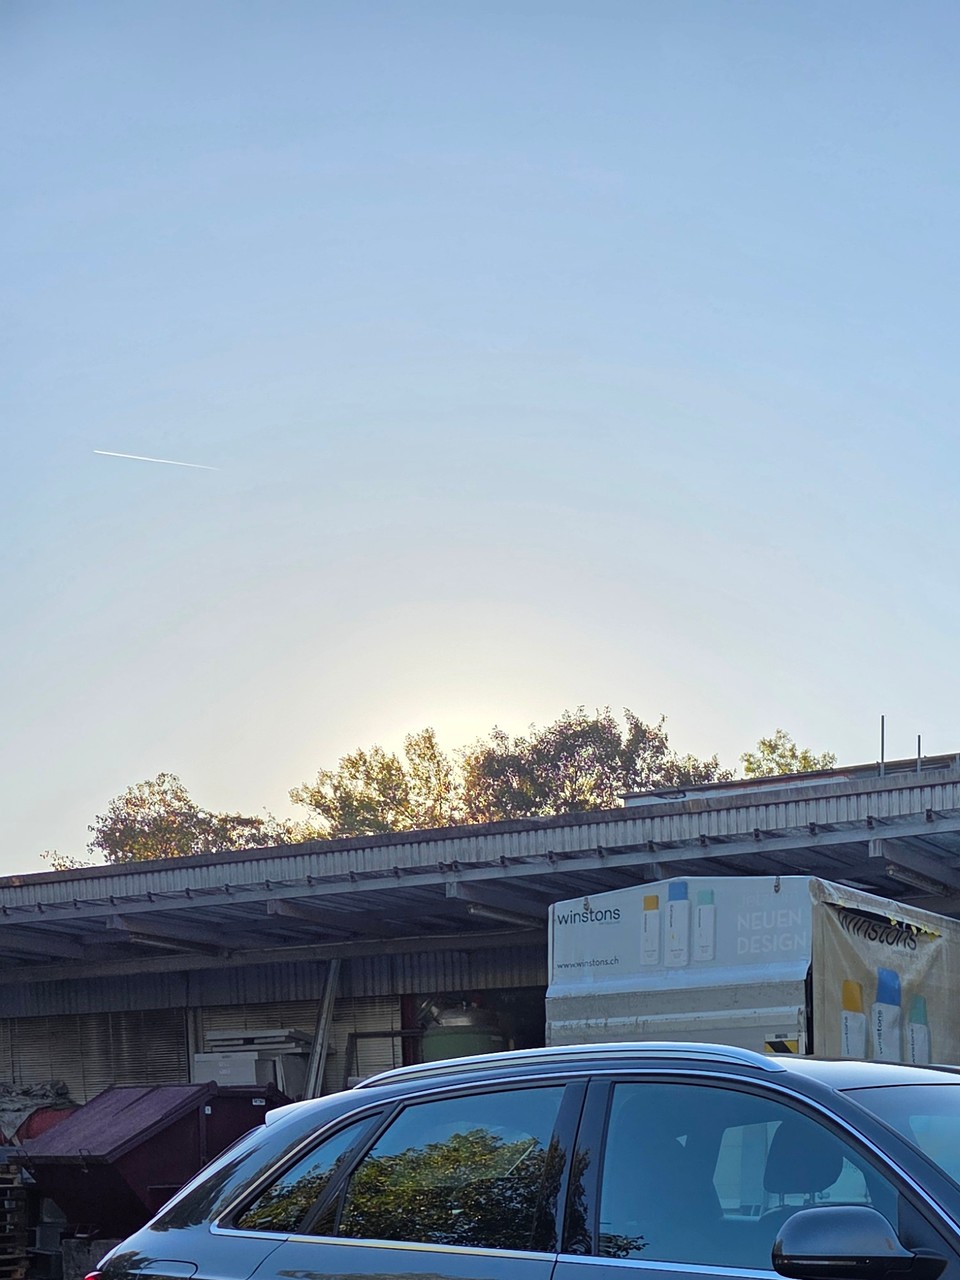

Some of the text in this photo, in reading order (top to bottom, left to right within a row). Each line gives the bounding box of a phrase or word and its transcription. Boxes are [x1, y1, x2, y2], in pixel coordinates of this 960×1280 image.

[557, 907, 621, 925] winstons
[737, 908, 802, 931] NEUEN
[837, 909, 918, 951] winstons
[737, 931, 807, 955] DESIGN
[556, 955, 620, 969] www.winstons.ch
